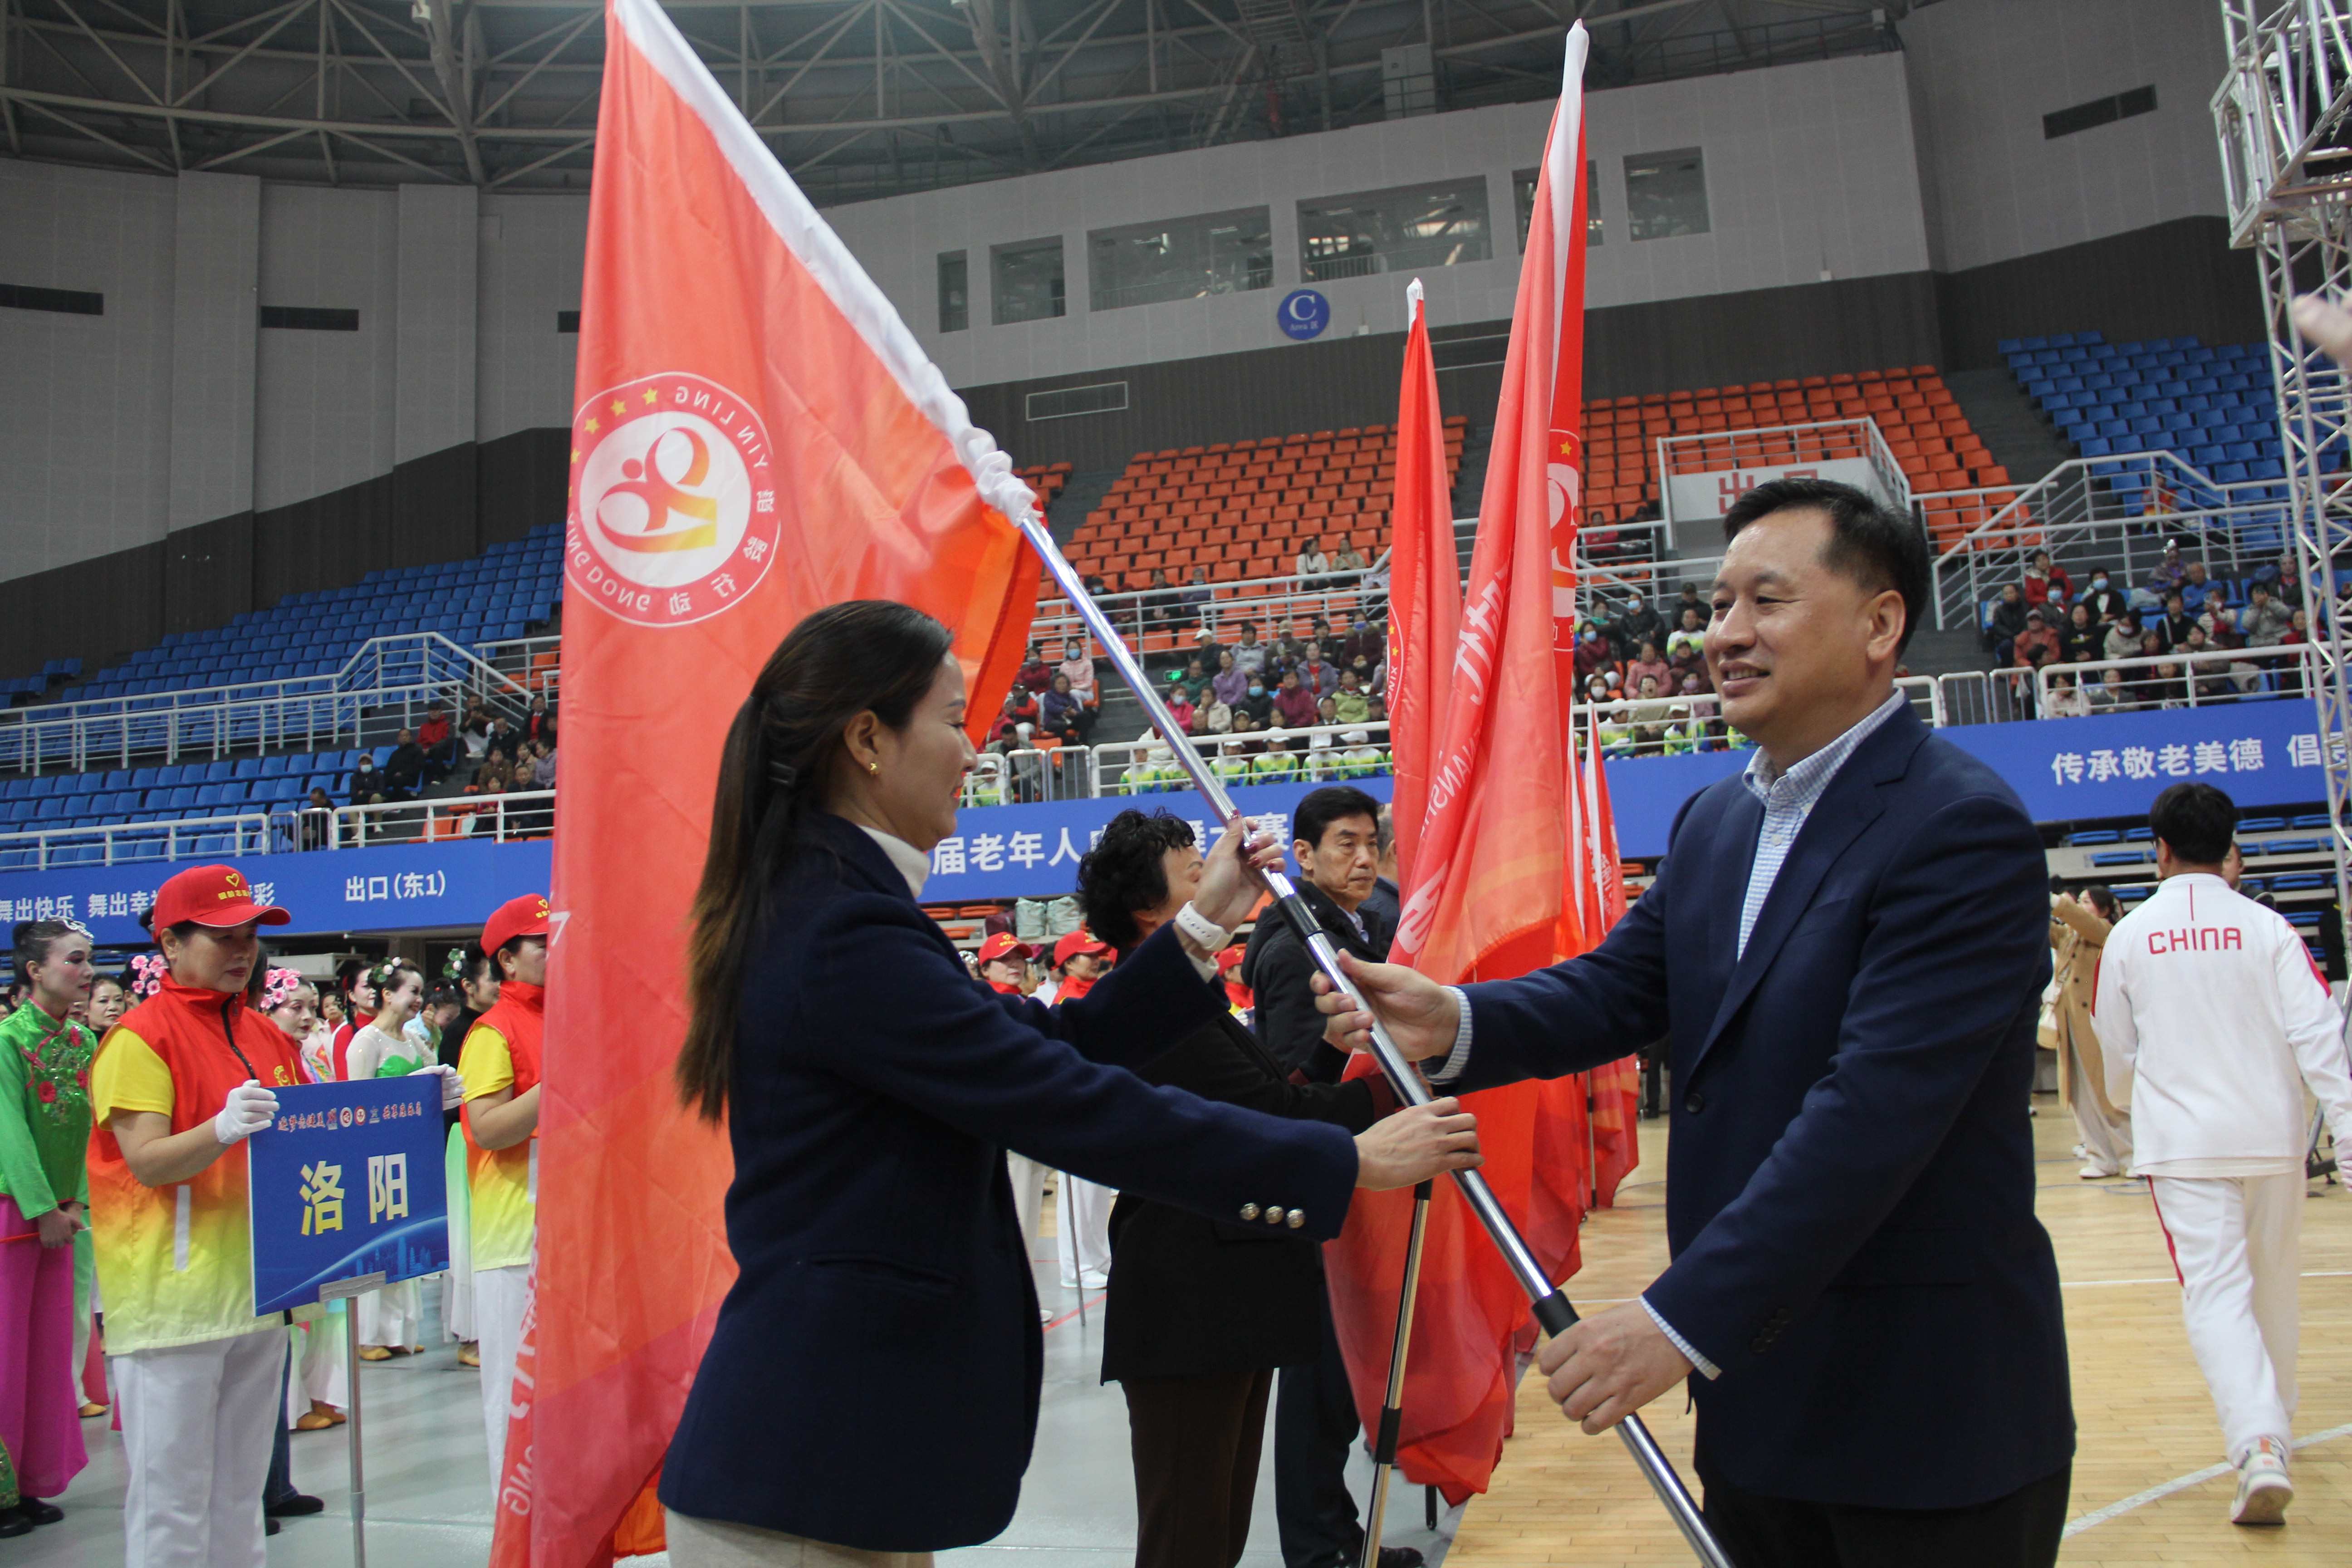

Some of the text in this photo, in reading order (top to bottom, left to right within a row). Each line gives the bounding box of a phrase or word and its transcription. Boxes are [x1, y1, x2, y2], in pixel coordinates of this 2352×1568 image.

[1289, 295, 1317, 321] C
[1718, 469, 1818, 514] 出
[2051, 737, 2264, 785] 传承敬老美德
[345, 869, 446, 902] 出口(东1)
[2148, 927, 2242, 955] CHINA
[299, 1152, 408, 1236] 洛阳
